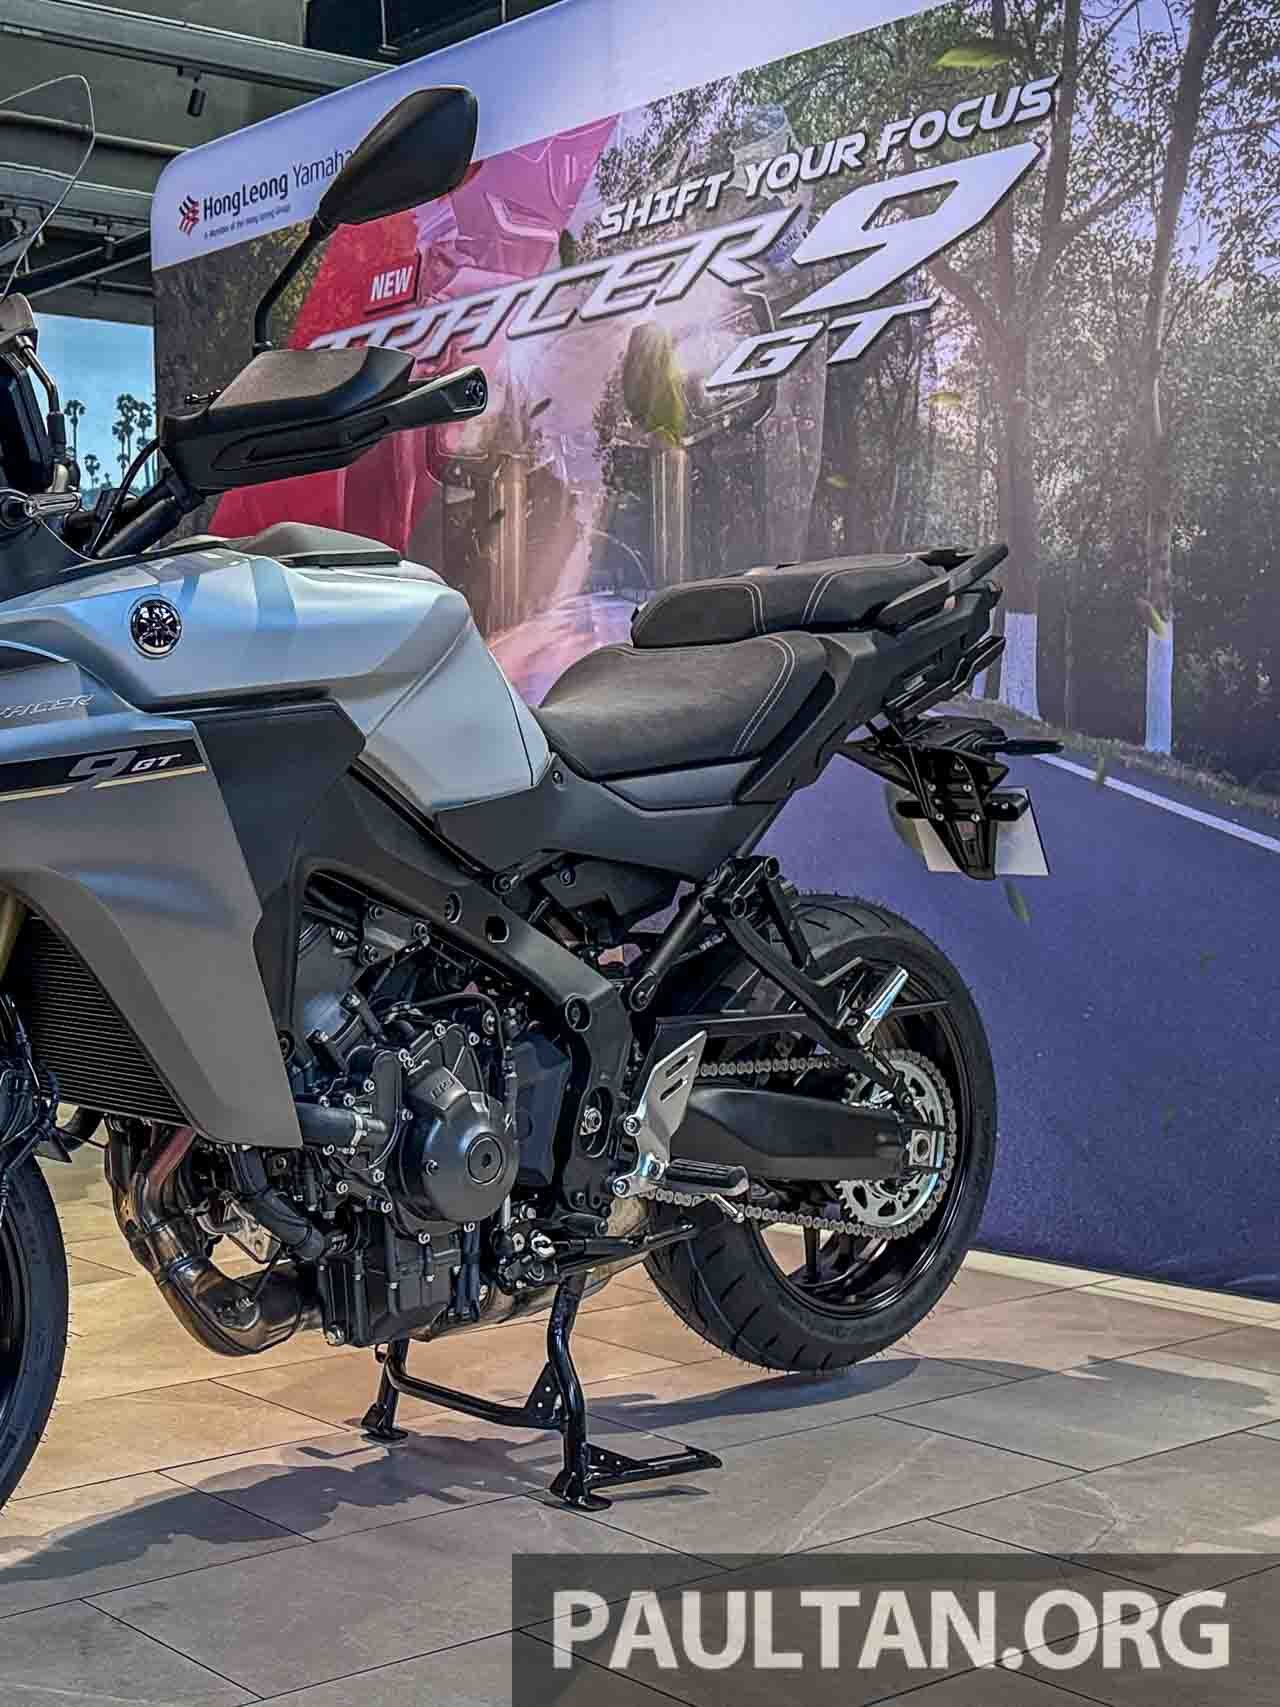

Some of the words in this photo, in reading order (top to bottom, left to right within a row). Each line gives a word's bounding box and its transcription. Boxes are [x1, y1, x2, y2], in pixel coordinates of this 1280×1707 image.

[597, 172, 732, 239] SHIFT
[744, 134, 867, 199] YOUR
[877, 74, 1059, 161] FOCUS
[780, 142, 1043, 319] 9
[370, 265, 414, 303] NEW
[706, 297, 941, 390] GT
[131, 754, 182, 772] GT
